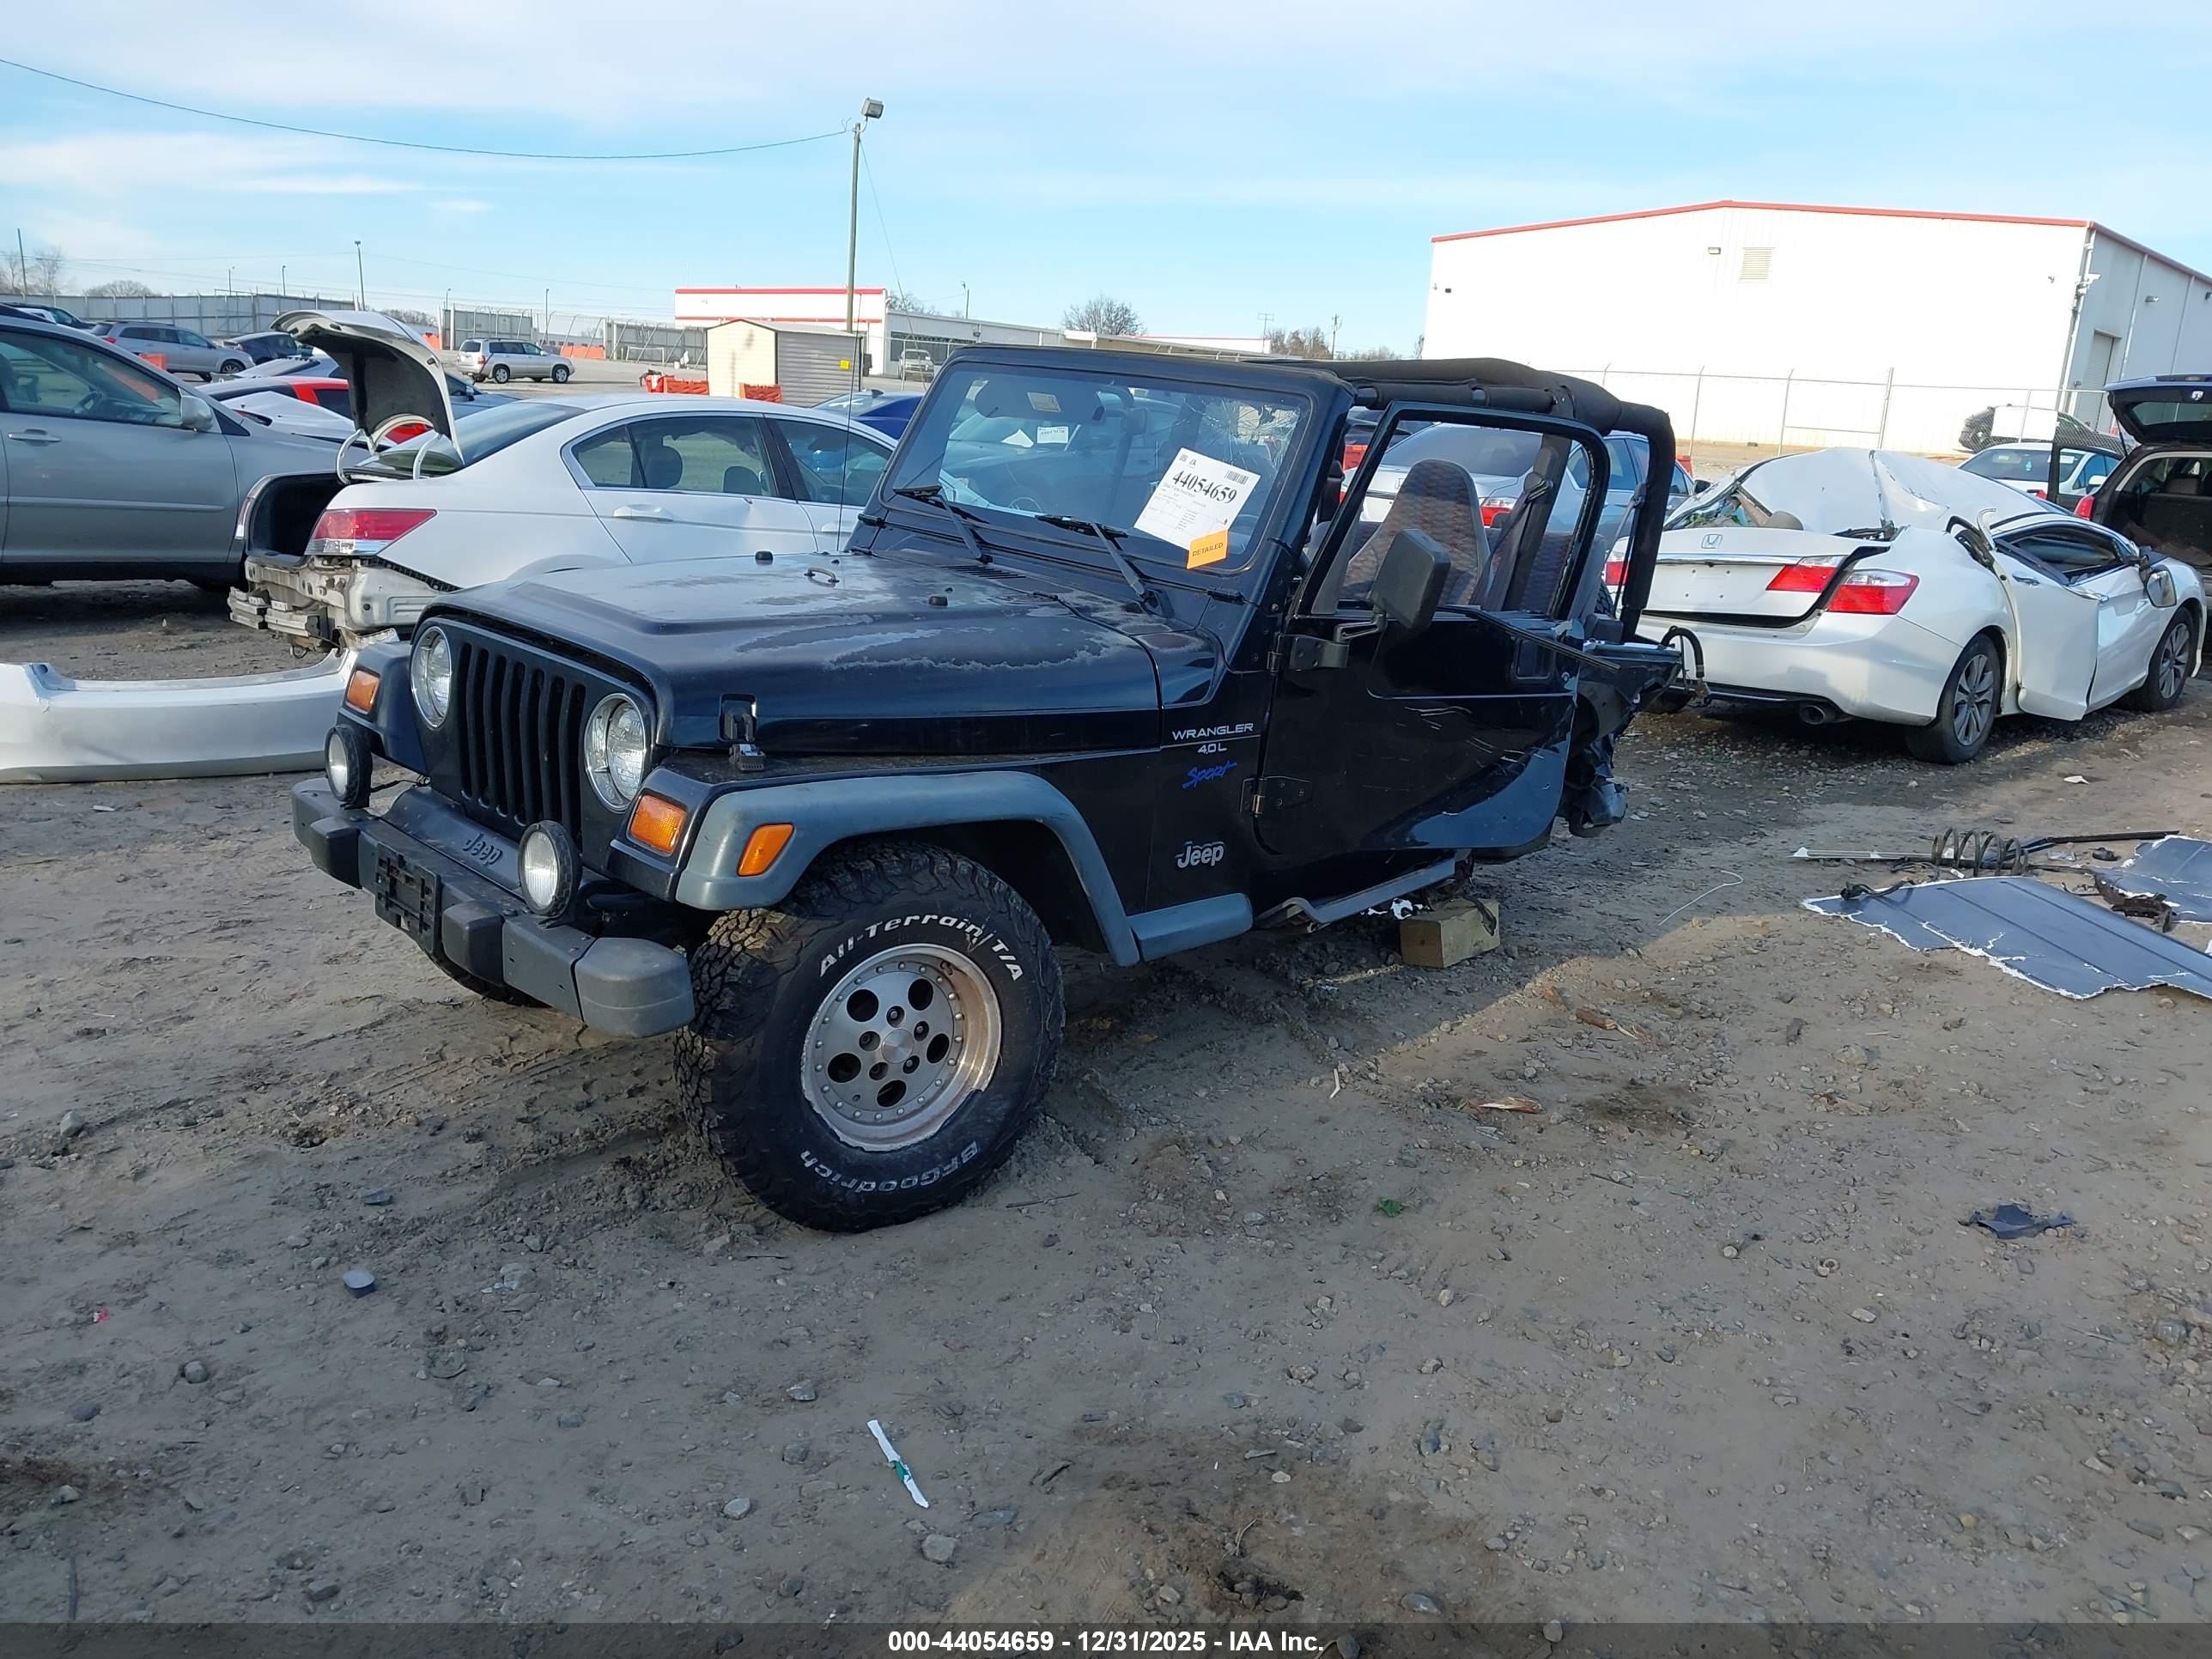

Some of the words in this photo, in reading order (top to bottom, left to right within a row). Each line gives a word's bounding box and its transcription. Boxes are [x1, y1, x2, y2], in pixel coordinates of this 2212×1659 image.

[1172, 470, 1237, 504] 44054659
[1192, 542, 1224, 557] DETAILED
[1172, 723, 1254, 741] WRANGLER
[1182, 760, 1237, 789] Sport
[461, 833, 503, 866] Jeep
[1175, 841, 1224, 868] Jeep
[819, 914, 984, 977] All-Terrain
[991, 939, 1024, 981] T/A
[799, 1140, 981, 1192] BFGoodrich
